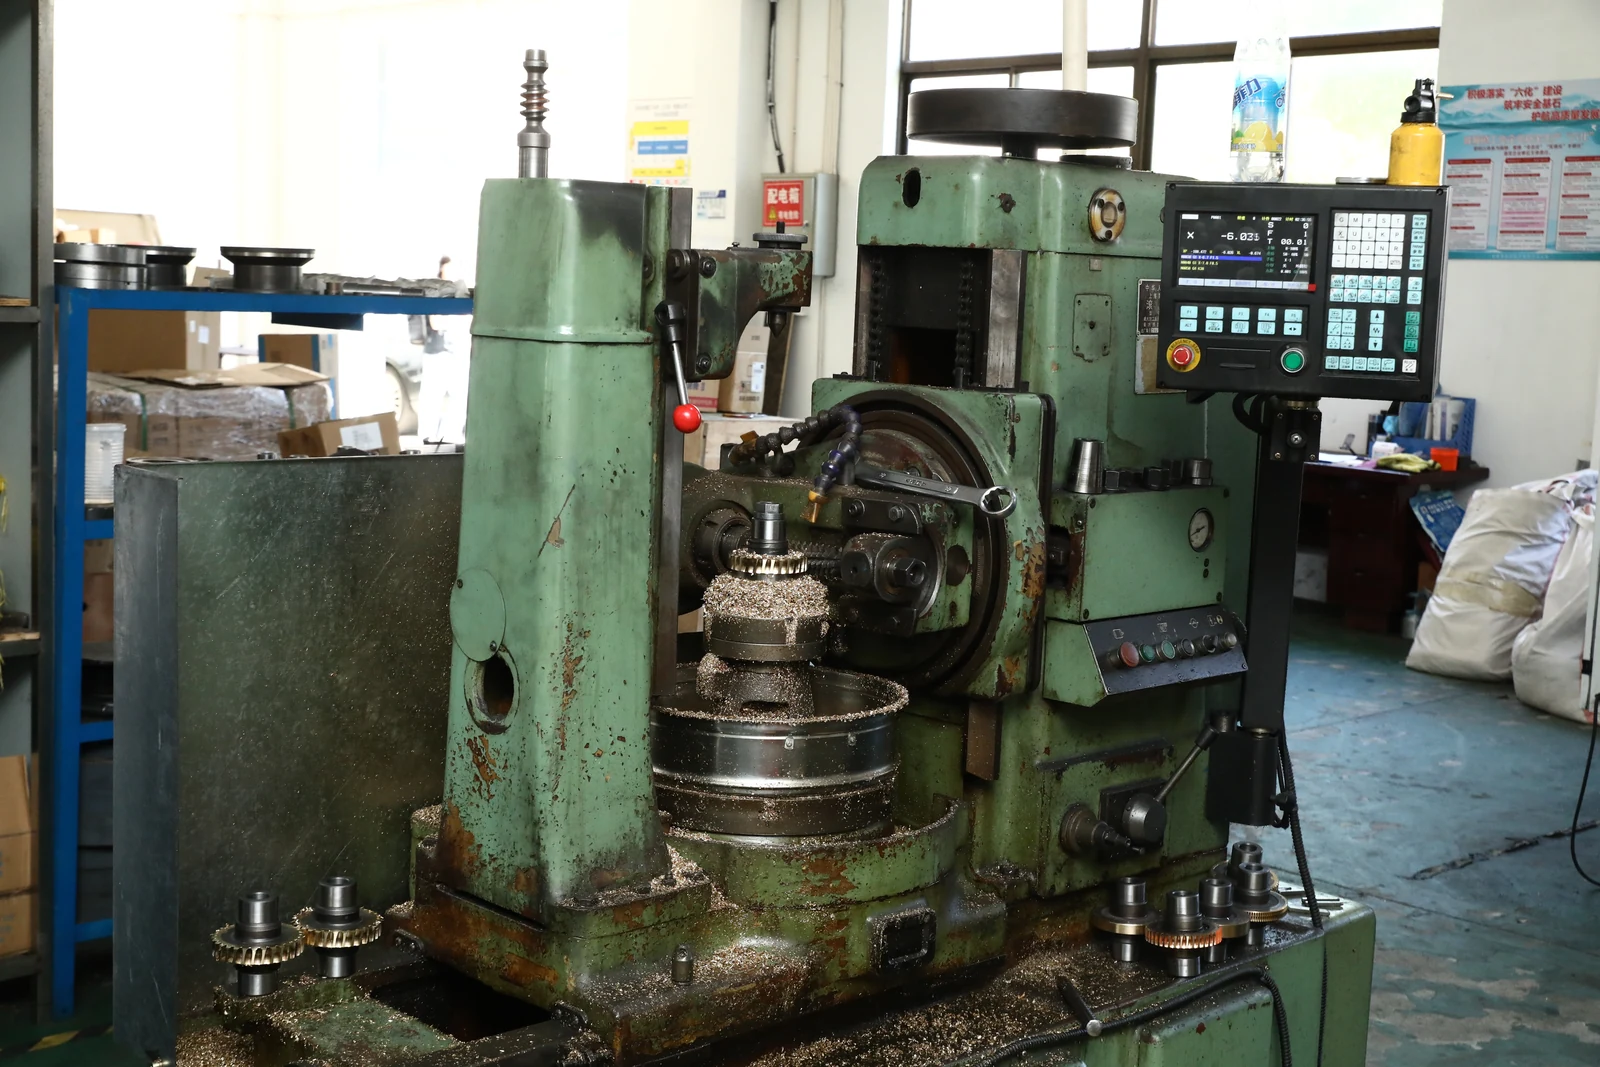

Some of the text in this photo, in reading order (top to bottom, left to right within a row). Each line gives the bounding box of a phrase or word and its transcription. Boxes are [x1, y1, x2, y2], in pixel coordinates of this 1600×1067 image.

[767, 187, 800, 204] 配电箱
[1186, 231, 1195, 239] X
